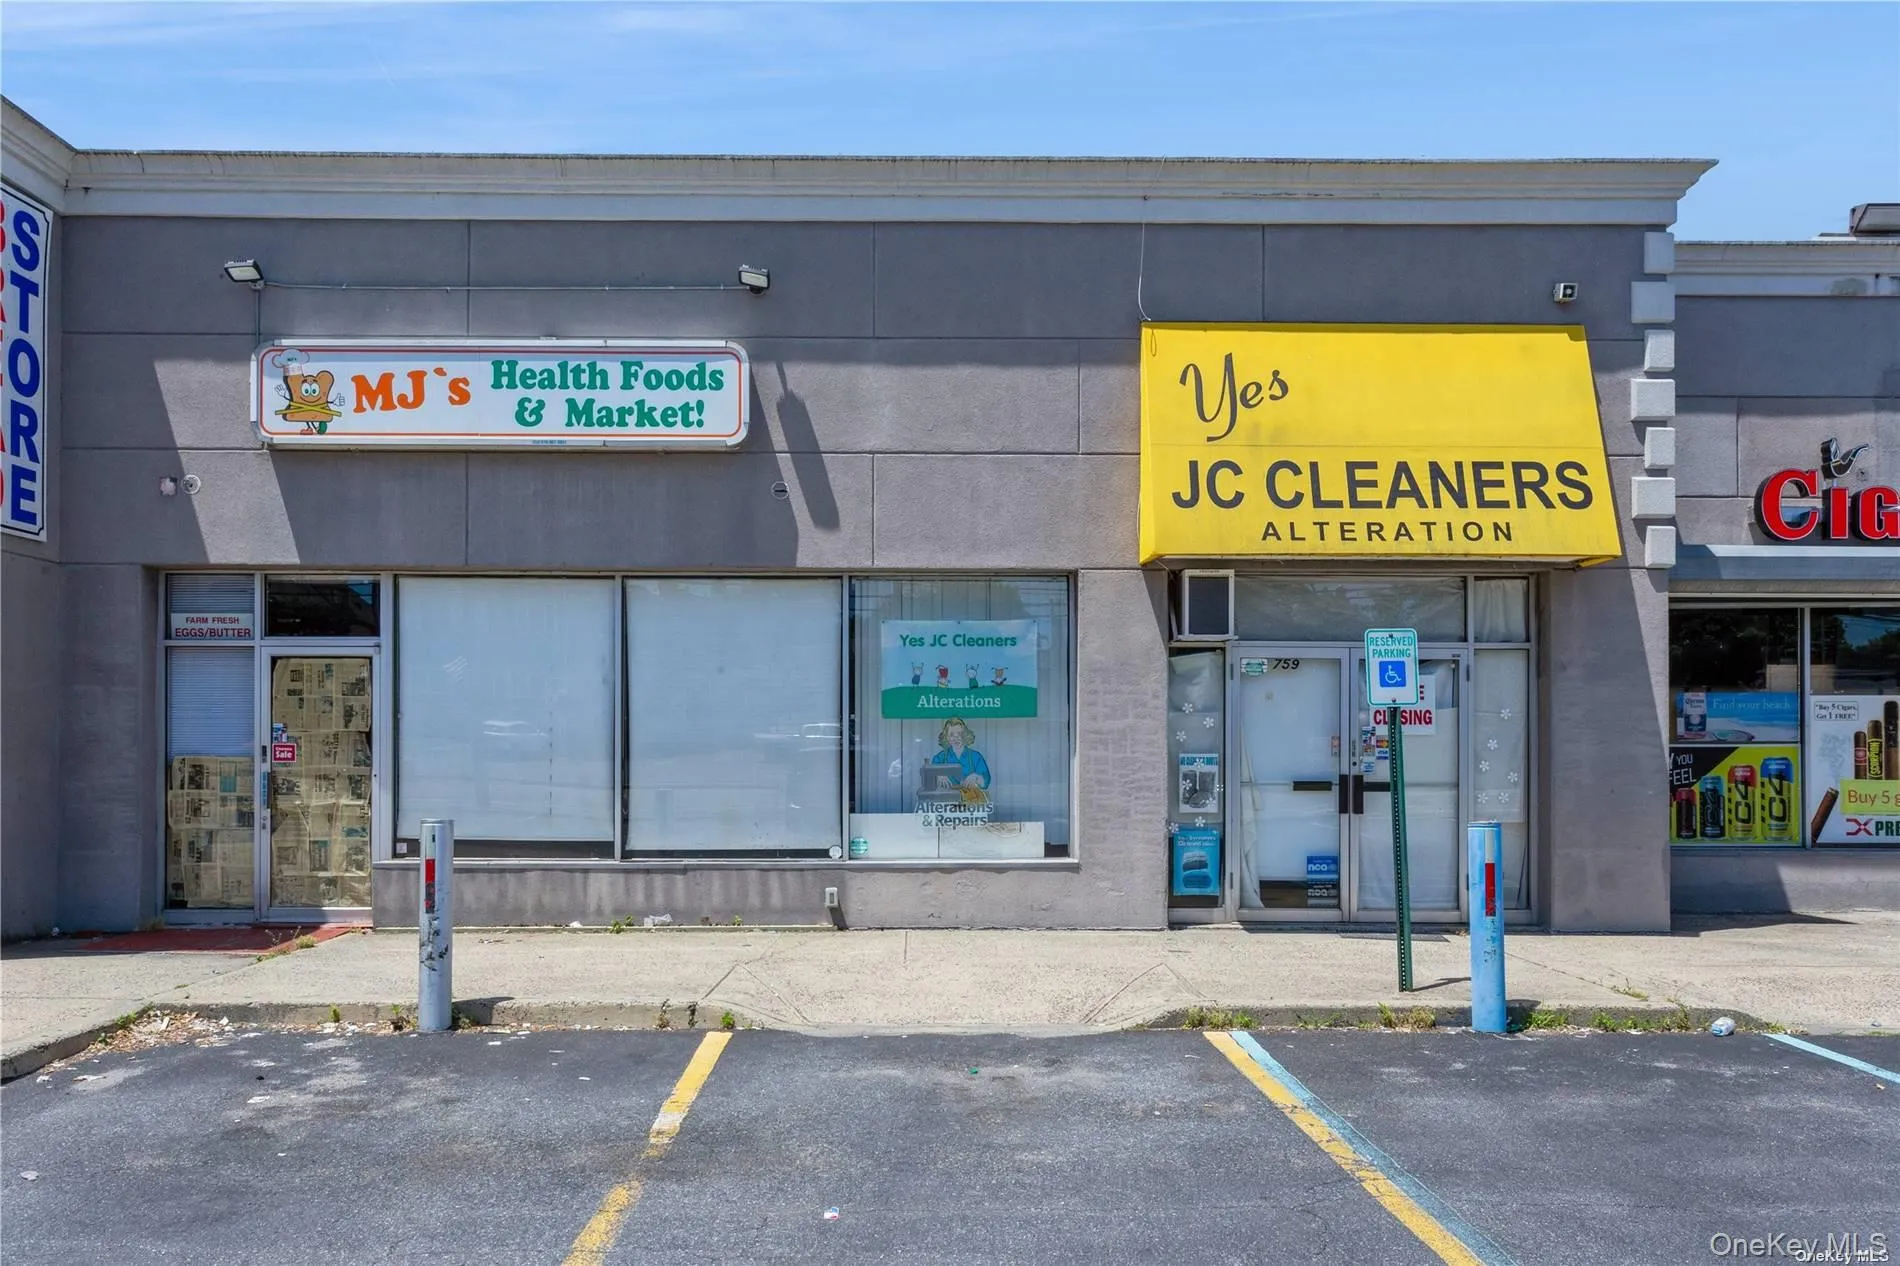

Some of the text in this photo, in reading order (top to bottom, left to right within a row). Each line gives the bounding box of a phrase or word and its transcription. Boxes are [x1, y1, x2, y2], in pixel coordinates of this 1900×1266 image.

[8, 209, 41, 527] STORE
[490, 359, 724, 391] Health Foods
[1179, 352, 1290, 443] Yes
[514, 397, 705, 429] & Market!
[1171, 459, 1593, 511] JC CLEANERS
[1261, 520, 1514, 542] ALTERATION
[185, 616, 240, 625] FARM FRESH
[175, 627, 251, 638] EGGS/BUTTER
[899, 633, 1017, 647] Yes JC Cleaners
[1369, 635, 1413, 647] RESERVED
[1372, 648, 1411, 659] PARKING
[1273, 659, 1300, 670] 759
[917, 695, 1001, 709] Alterations
[1373, 709, 1433, 726] CLSING
[275, 750, 293, 759] Sale
[1676, 753, 1693, 766] YOU
[1847, 789, 1877, 808] Buy
[1881, 790, 1890, 804] 5
[915, 801, 994, 816] Alterations
[922, 814, 988, 830] & Repairs
